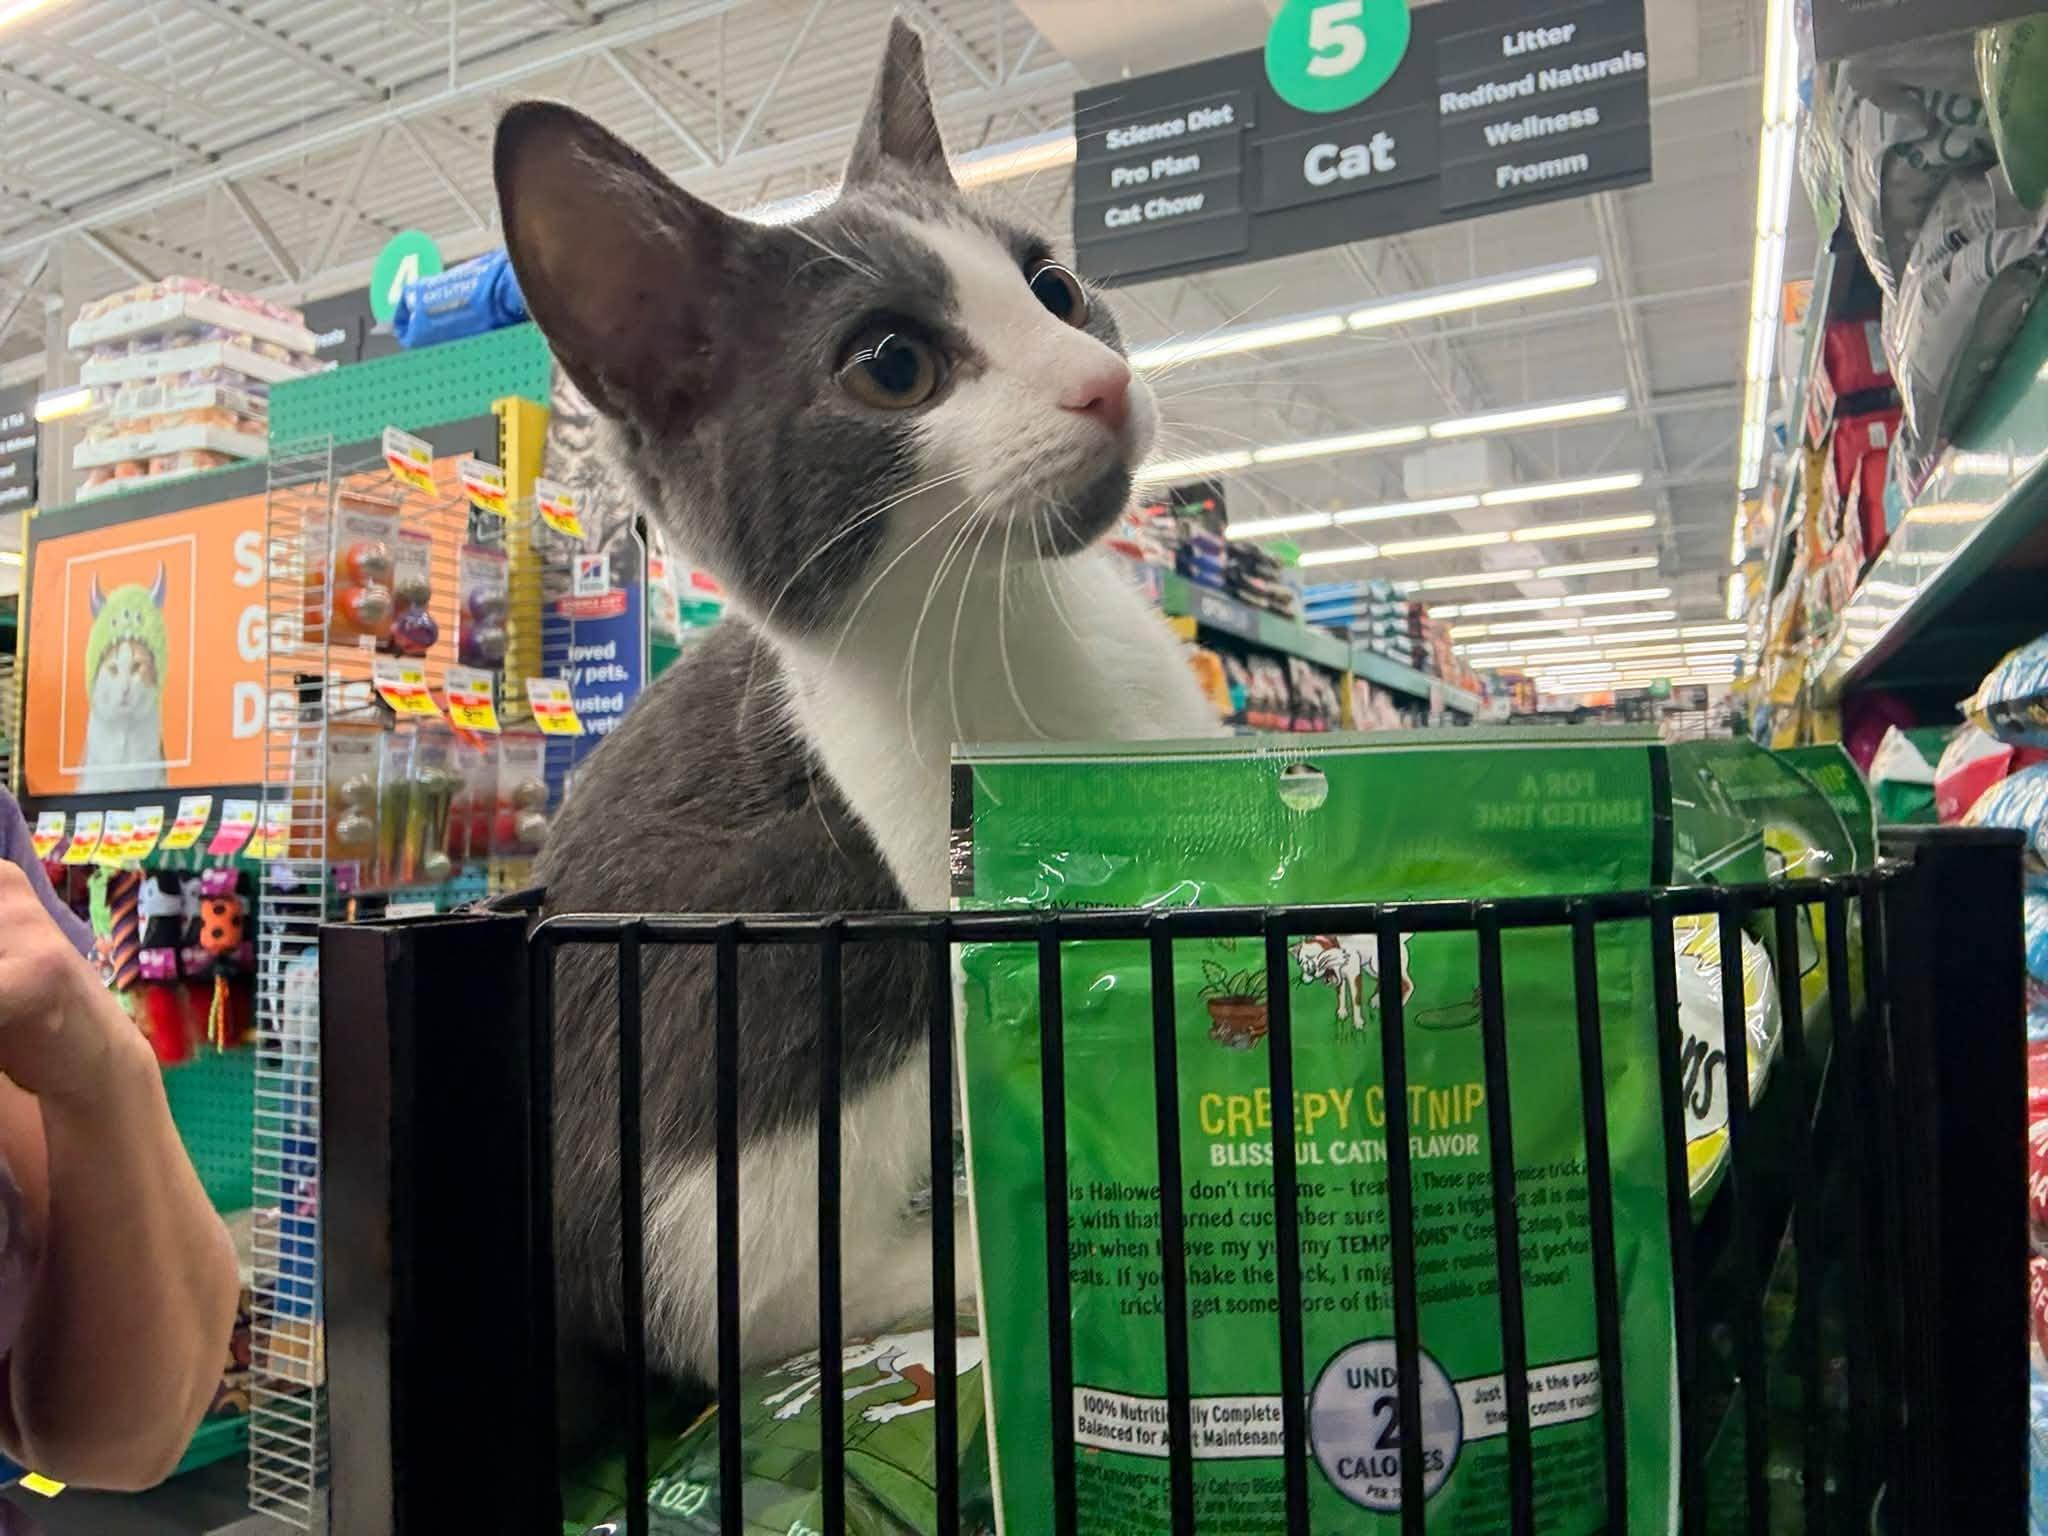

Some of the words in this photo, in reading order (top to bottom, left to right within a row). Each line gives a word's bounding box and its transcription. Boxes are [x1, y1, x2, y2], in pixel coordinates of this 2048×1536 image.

[1305, 0, 1366, 77] 5
[1502, 23, 1576, 56] Litter
[1439, 72, 1535, 115] Redford
[1538, 50, 1647, 91] Naturals
[1105, 117, 1187, 149] Science
[1187, 103, 1235, 132] Diet
[1483, 106, 1600, 147] Wellness
[1111, 166, 1150, 188] Pro
[1151, 154, 1200, 180] Plan
[1303, 132, 1396, 186] Cat
[1496, 152, 1589, 189] Fromm
[1104, 203, 1143, 228] Cat
[1144, 192, 1206, 220] Chow
[567, 639, 617, 663] loved
[584, 663, 630, 687] pets.
[574, 691, 624, 713] usted
[1365, 1083, 1486, 1130] CTNIP
[1209, 1140, 1325, 1167] BLISSUL
[1408, 1133, 1480, 1160] FLAVOR
[1089, 1181, 1161, 1200] Hallowe
[1189, 1179, 1240, 1200] don't
[1245, 1179, 1276, 1198] tric
[1080, 1209, 1121, 1229] with
[1125, 1209, 1161, 1229] that
[1239, 1206, 1337, 1226] cucber
[1344, 1209, 1386, 1226] sure
[1100, 1237, 1150, 1257] when
[1221, 1239, 1251, 1262] my
[1117, 1265, 1131, 1286] If
[1136, 1270, 1161, 1291] yo
[1188, 1264, 1237, 1285] hake
[1242, 1263, 1275, 1284] the
[1191, 1297, 1222, 1318] get
[1226, 1297, 1281, 1314] some
[1301, 1295, 1336, 1312] ore
[1340, 1291, 1360, 1311] of
[1473, 1386, 1502, 1405] Just
[1546, 1375, 1569, 1391] the
[1083, 1395, 1117, 1418] 100%
[1119, 1403, 1209, 1427] Nutritilly
[1212, 1404, 1281, 1426] Complete
[1373, 1395, 1404, 1450] 2
[1530, 1399, 1568, 1416] come
[1078, 1415, 1133, 1443] Balanced
[1136, 1426, 1158, 1444] for
[1203, 1429, 1286, 1447] Maintenanc
[1337, 1449, 1445, 1479] CALOES
